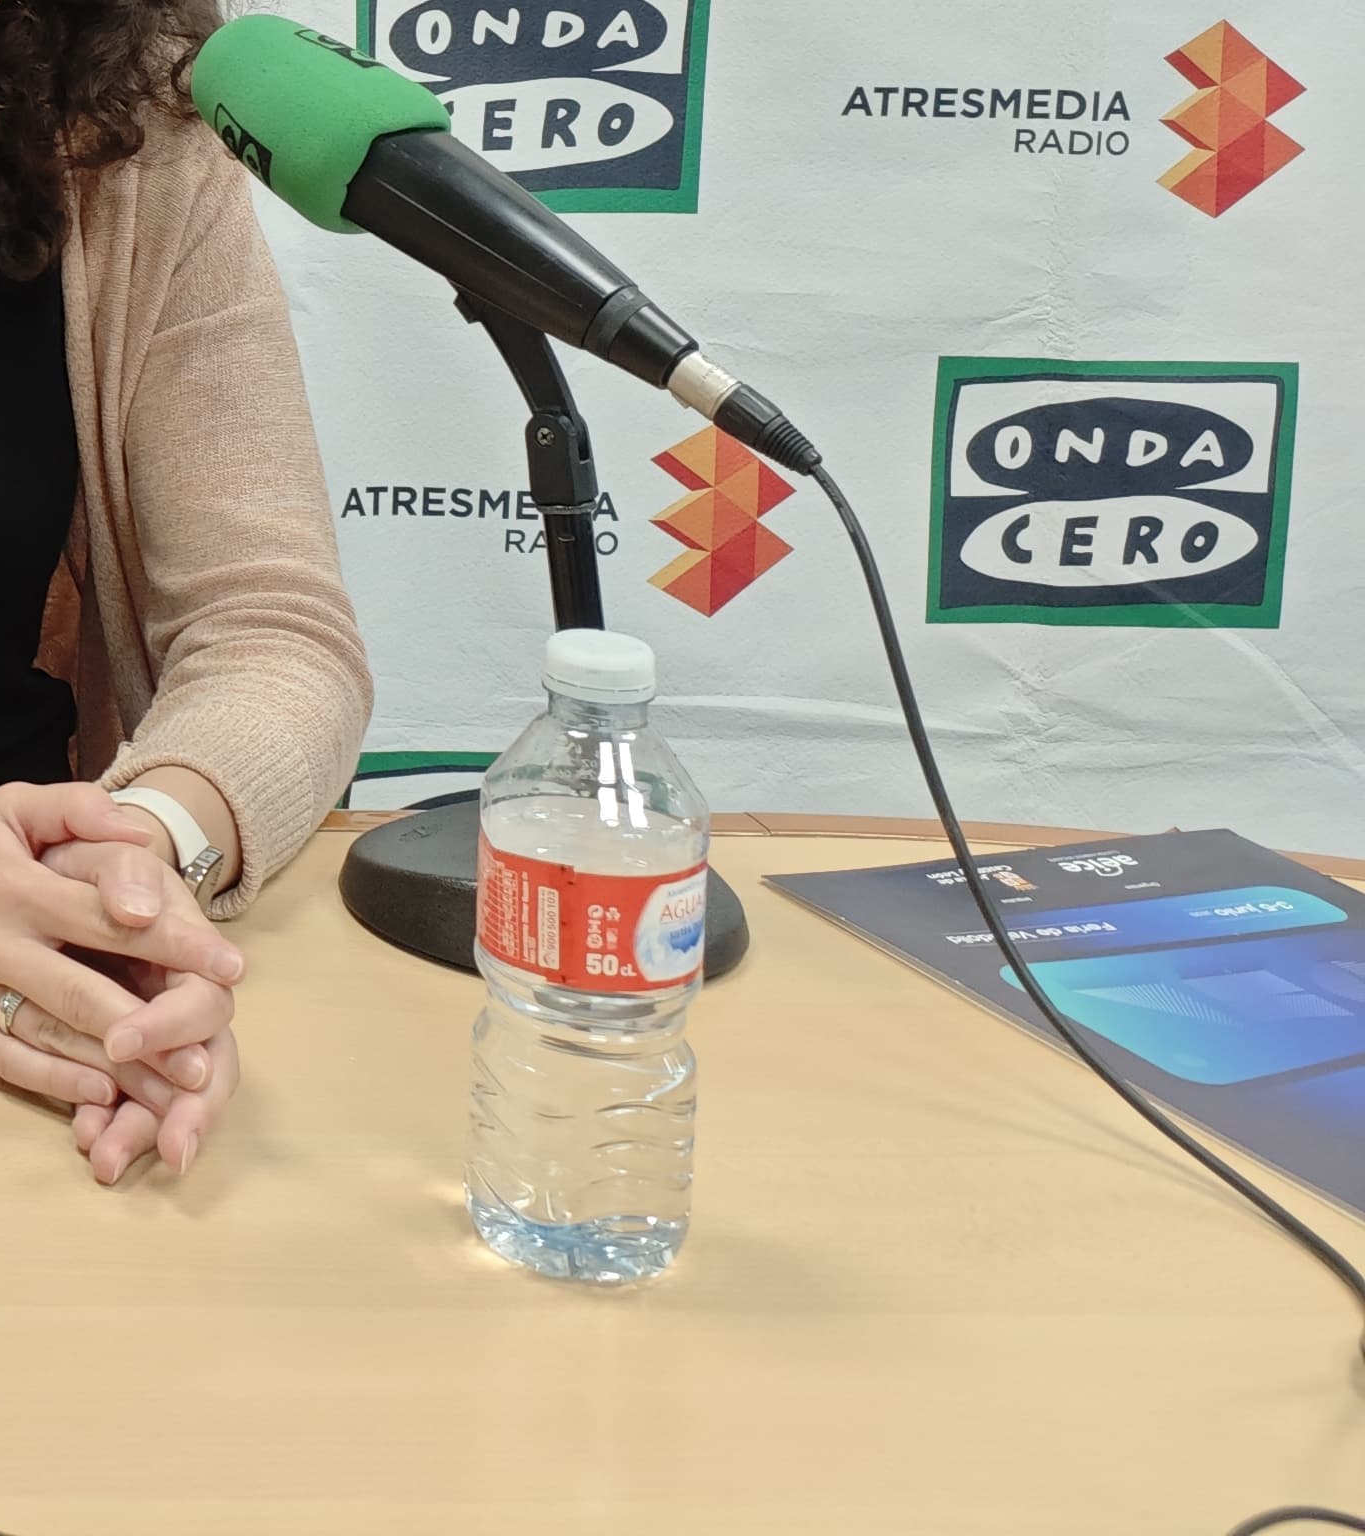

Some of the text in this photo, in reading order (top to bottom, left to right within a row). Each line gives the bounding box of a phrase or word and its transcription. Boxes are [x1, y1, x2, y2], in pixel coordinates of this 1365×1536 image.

[415, 7, 640, 55] ONDA
[841, 86, 1131, 121] ATRESMEDIA
[443, 98, 635, 151] ERO
[1013, 128, 1130, 156] RADIO
[994, 425, 1225, 470] ONDA
[340, 486, 619, 522] ATRESMEA
[504, 529, 619, 556] RAO
[1001, 514, 1219, 567] CERO
[1063, 921, 1118, 935] Feria
[586, 952, 618, 977] 50
